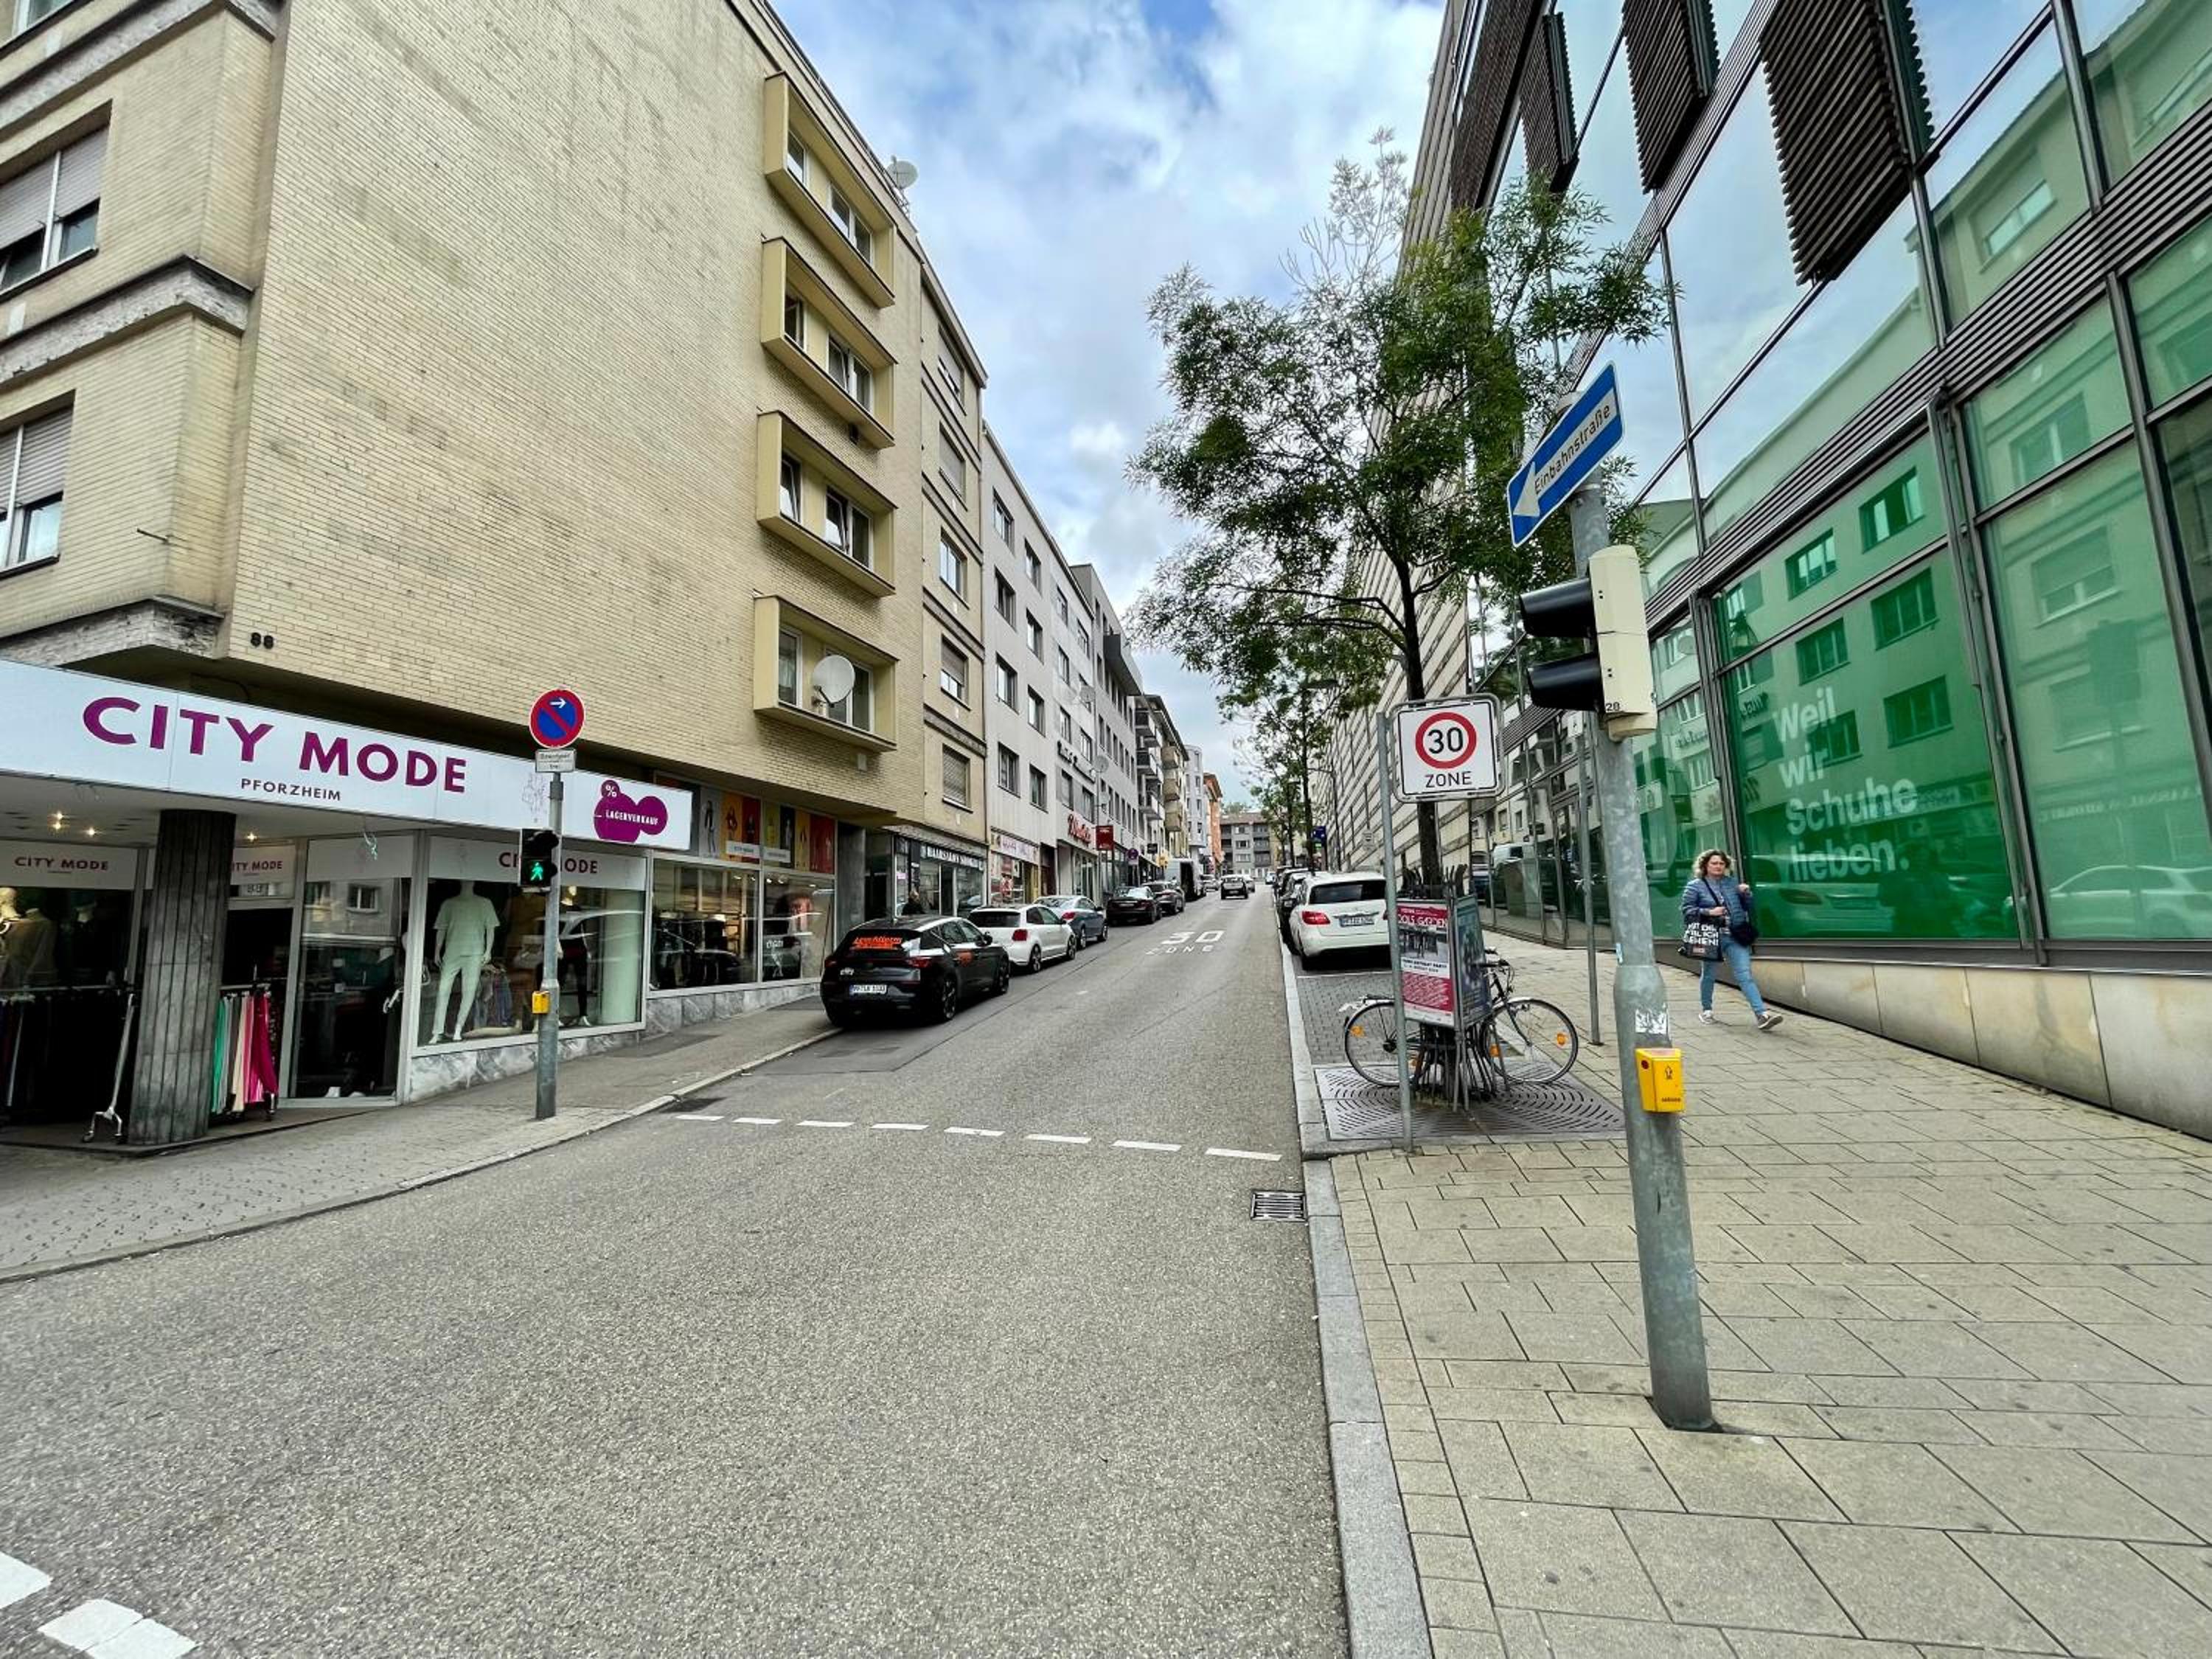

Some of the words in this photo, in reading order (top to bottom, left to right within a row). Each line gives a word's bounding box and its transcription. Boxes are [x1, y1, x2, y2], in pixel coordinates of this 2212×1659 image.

[1534, 405, 1610, 493] Einbahnstraße
[1775, 686, 1836, 743] Weil
[83, 697, 274, 762] CITY
[299, 731, 467, 793] MODE
[1427, 726, 1464, 754] 30
[241, 778, 341, 801] PFORZHEIM
[1425, 771, 1472, 788] ZONE
[1785, 776, 1918, 835] Schuhe
[15, 855, 56, 869] CITY
[60, 859, 109, 871] MODE
[251, 860, 283, 872] MODE
[1790, 837, 1910, 882] lieben.
[1161, 931, 1225, 945] 30
